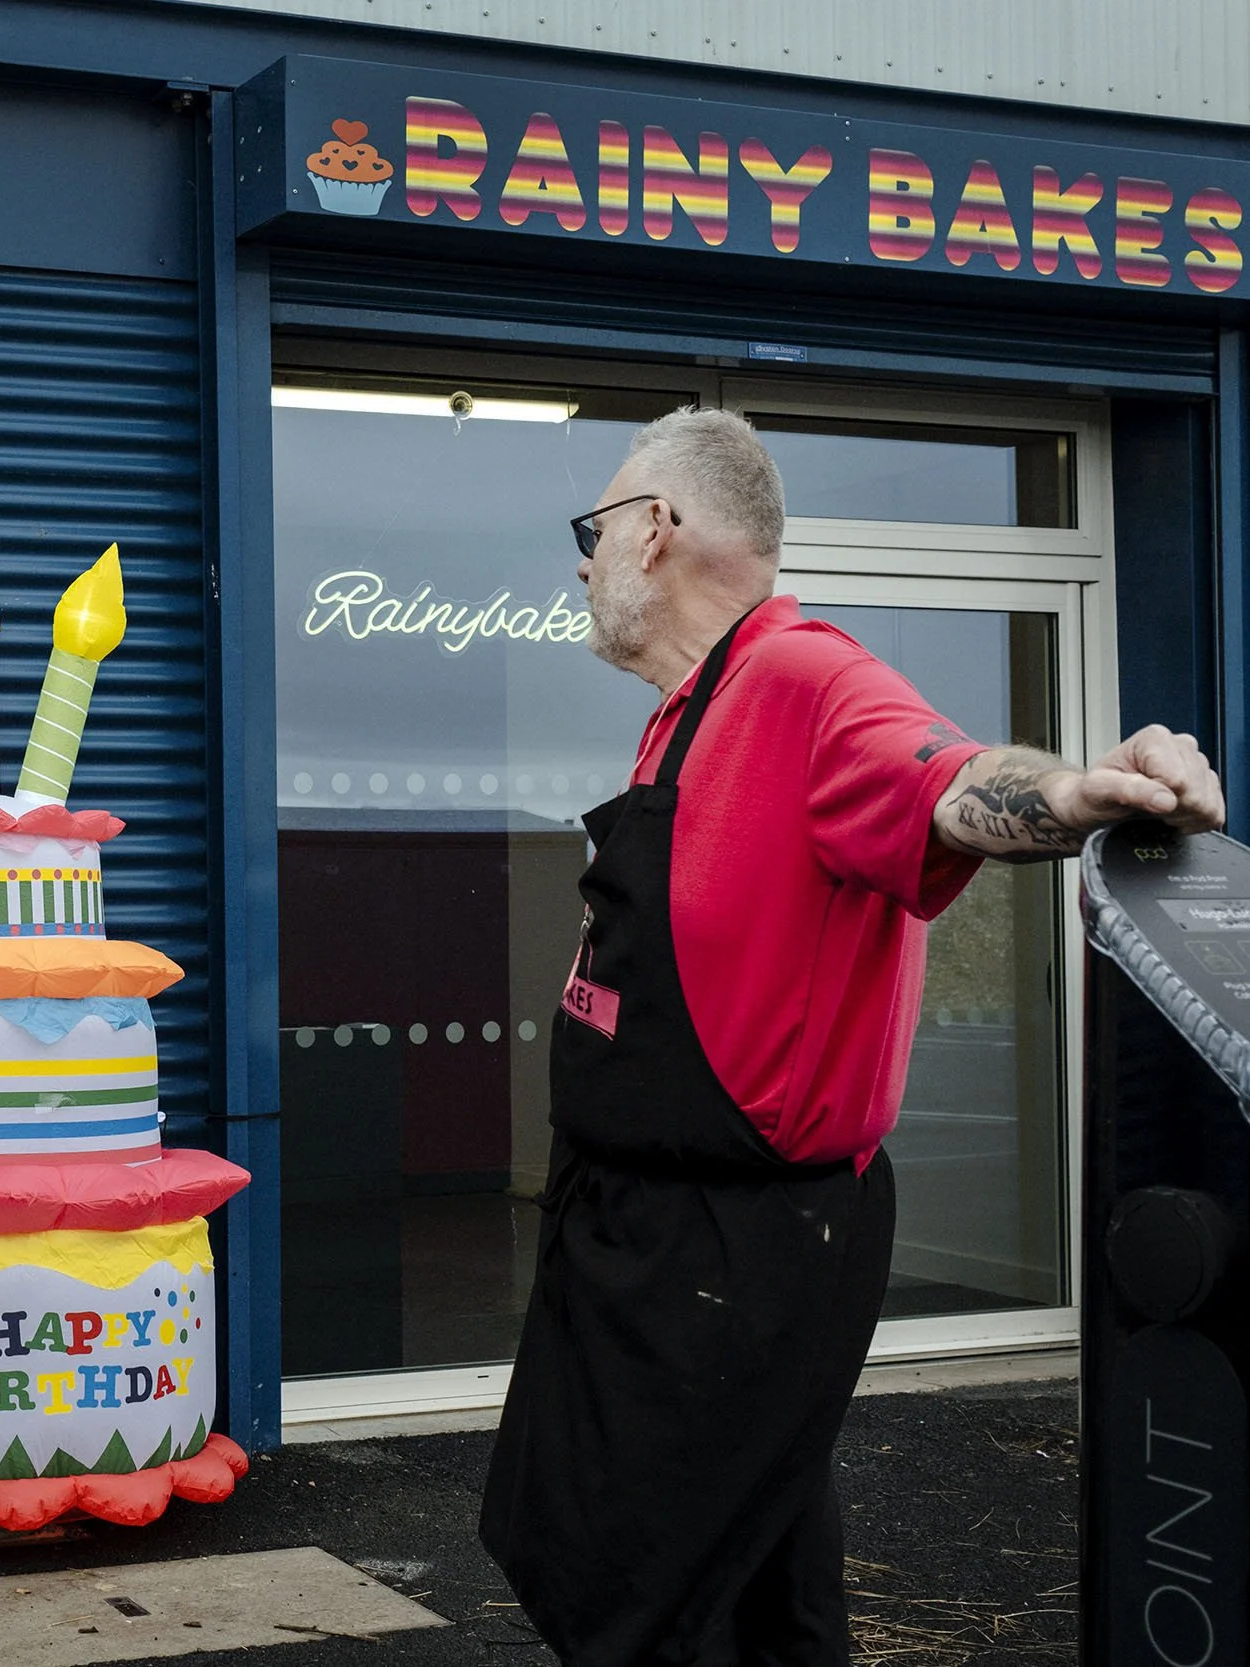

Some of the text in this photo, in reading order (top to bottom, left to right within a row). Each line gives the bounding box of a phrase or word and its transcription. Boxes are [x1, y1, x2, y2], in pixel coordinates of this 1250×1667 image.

[405, 95, 1245, 294] RAINY BAKES
[304, 570, 593, 652] Rainybake
[566, 984, 593, 1014] KES
[1144, 1397, 1214, 1667] OINT
